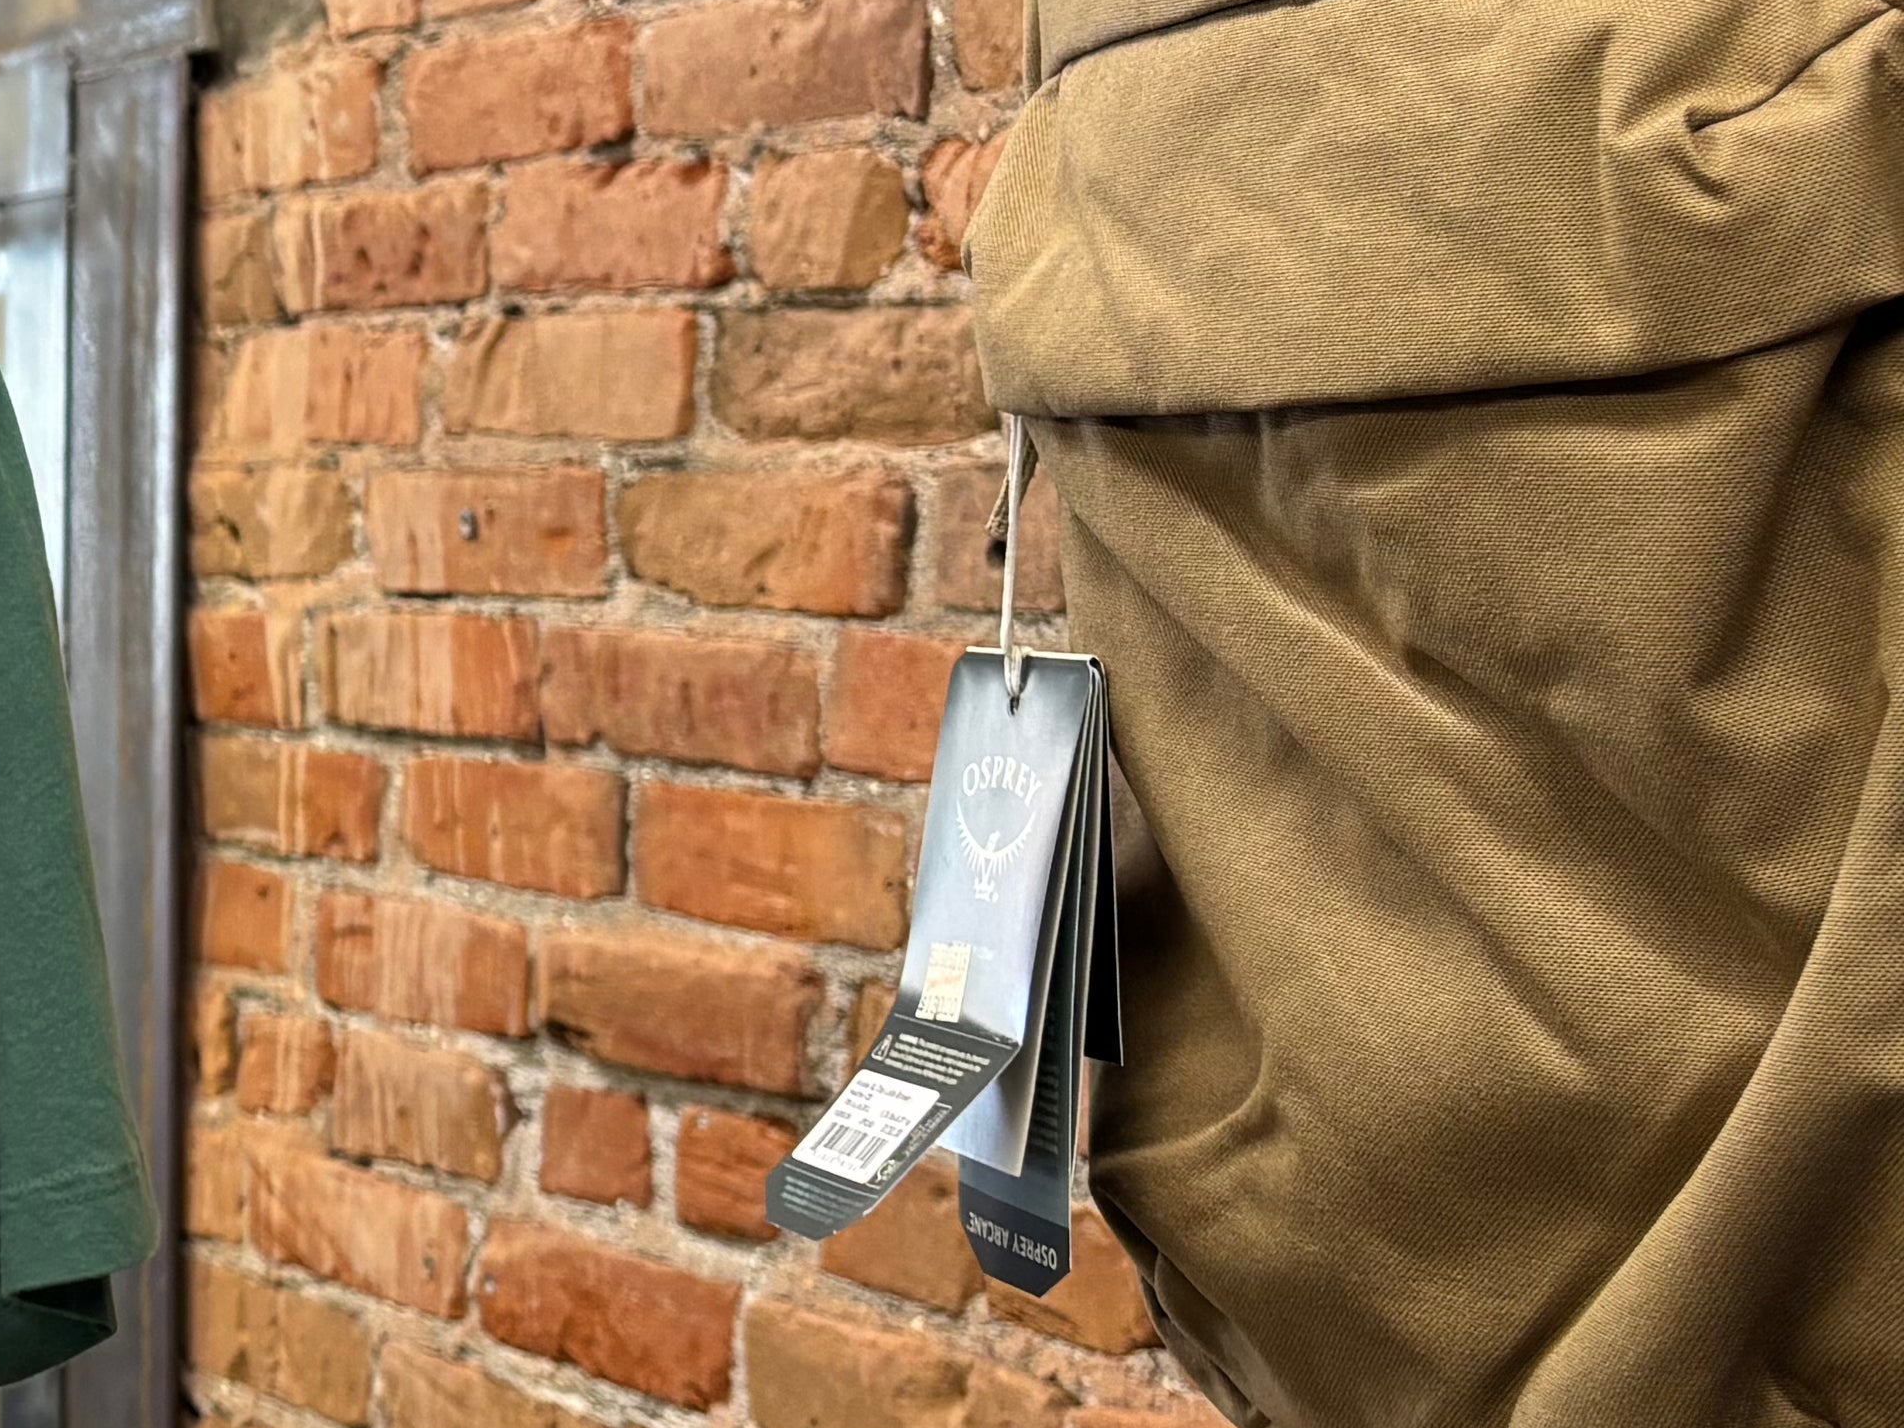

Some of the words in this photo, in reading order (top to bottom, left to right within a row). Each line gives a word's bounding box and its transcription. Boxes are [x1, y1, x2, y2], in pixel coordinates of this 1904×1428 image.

[961, 754, 1043, 808] OSPREY
[966, 1211, 1010, 1249] ARCANE
[1012, 1232, 1059, 1271] OSPREY
